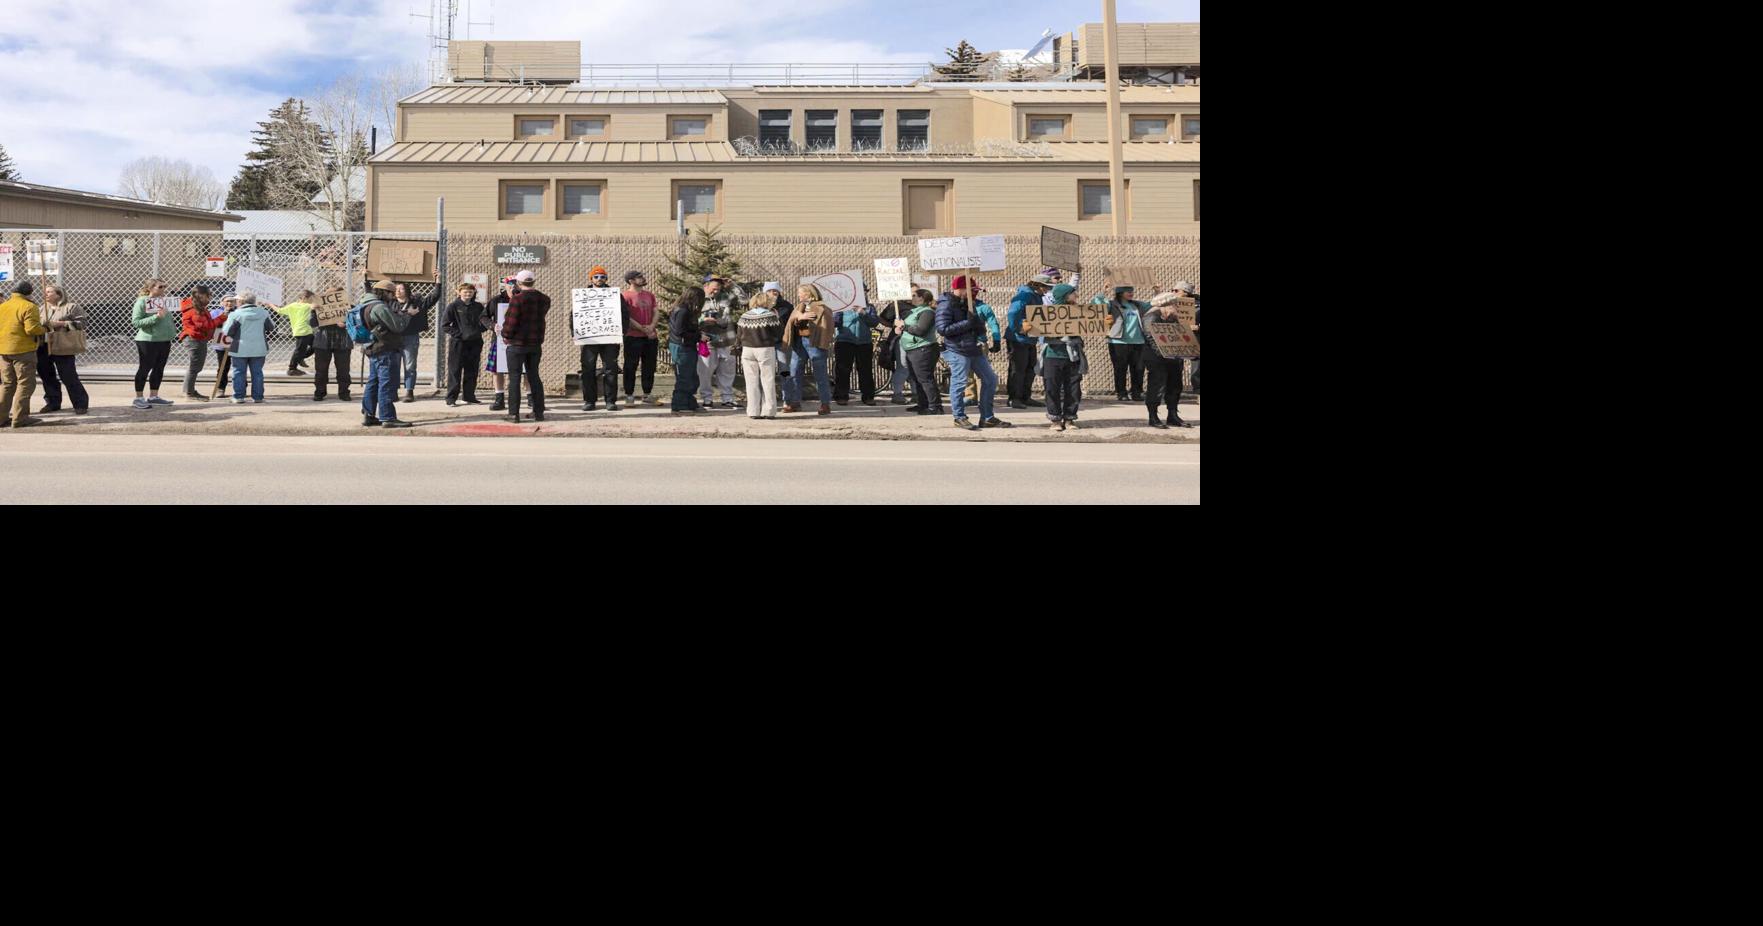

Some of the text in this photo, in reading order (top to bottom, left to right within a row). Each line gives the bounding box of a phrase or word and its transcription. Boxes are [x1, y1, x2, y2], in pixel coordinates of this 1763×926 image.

[924, 237, 970, 249] DEPORT
[923, 256, 982, 268] NATIONALISTS
[1130, 266, 1153, 285] OUT
[320, 292, 343, 306] ICE
[574, 288, 618, 300] ABOLISH
[580, 299, 605, 309] ICE
[1030, 305, 1105, 322] ABOLISH
[575, 324, 620, 336] REFORMED
[1039, 320, 1106, 335] ICE NOW
